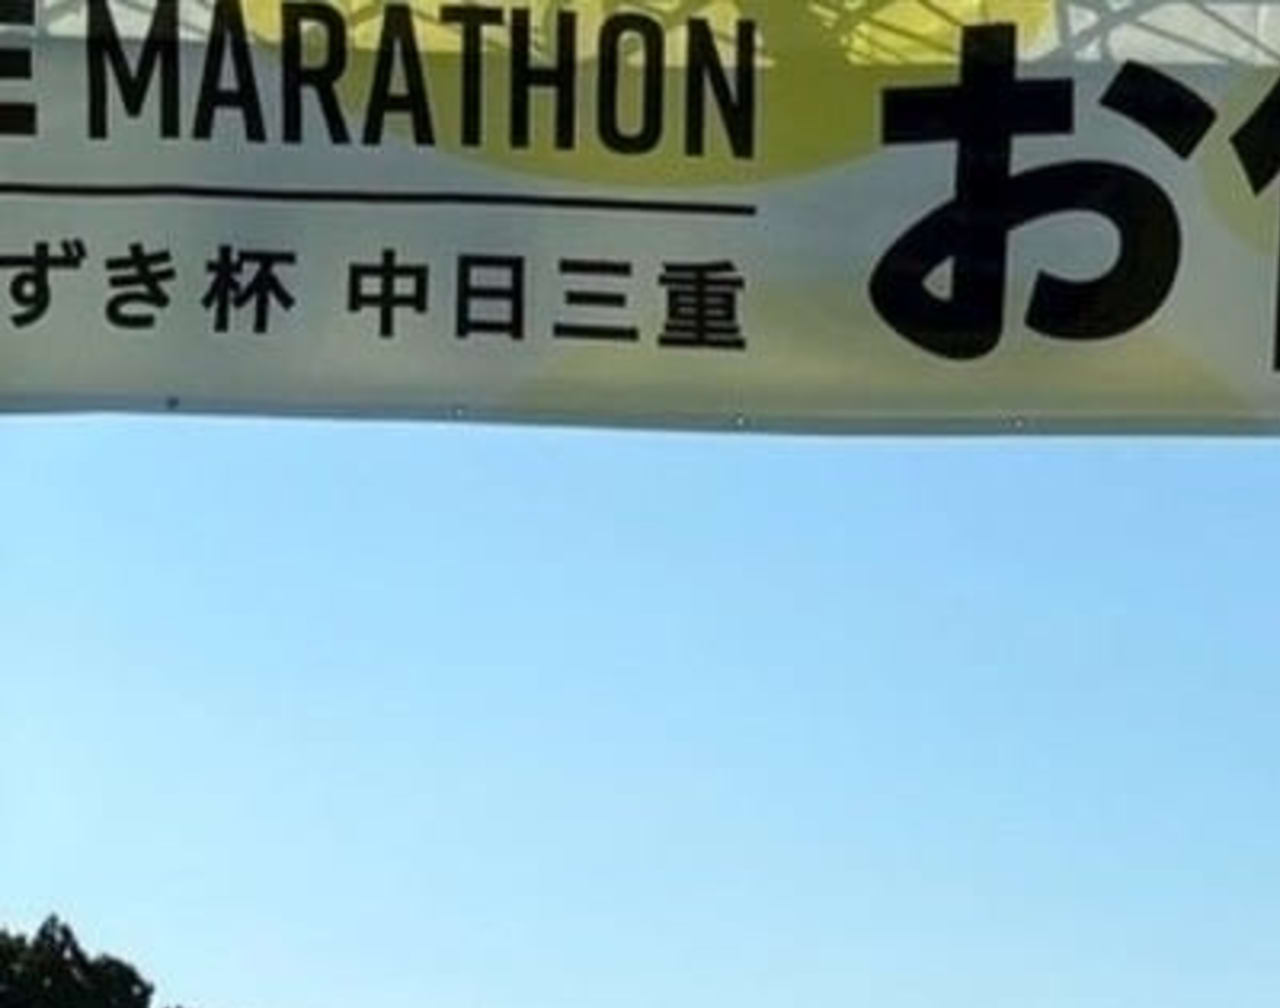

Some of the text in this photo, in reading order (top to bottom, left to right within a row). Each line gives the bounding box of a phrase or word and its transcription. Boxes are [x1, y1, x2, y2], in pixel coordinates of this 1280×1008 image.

[87, 0, 757, 160] MARATHON
[346, 249, 748, 351] 中日三重
